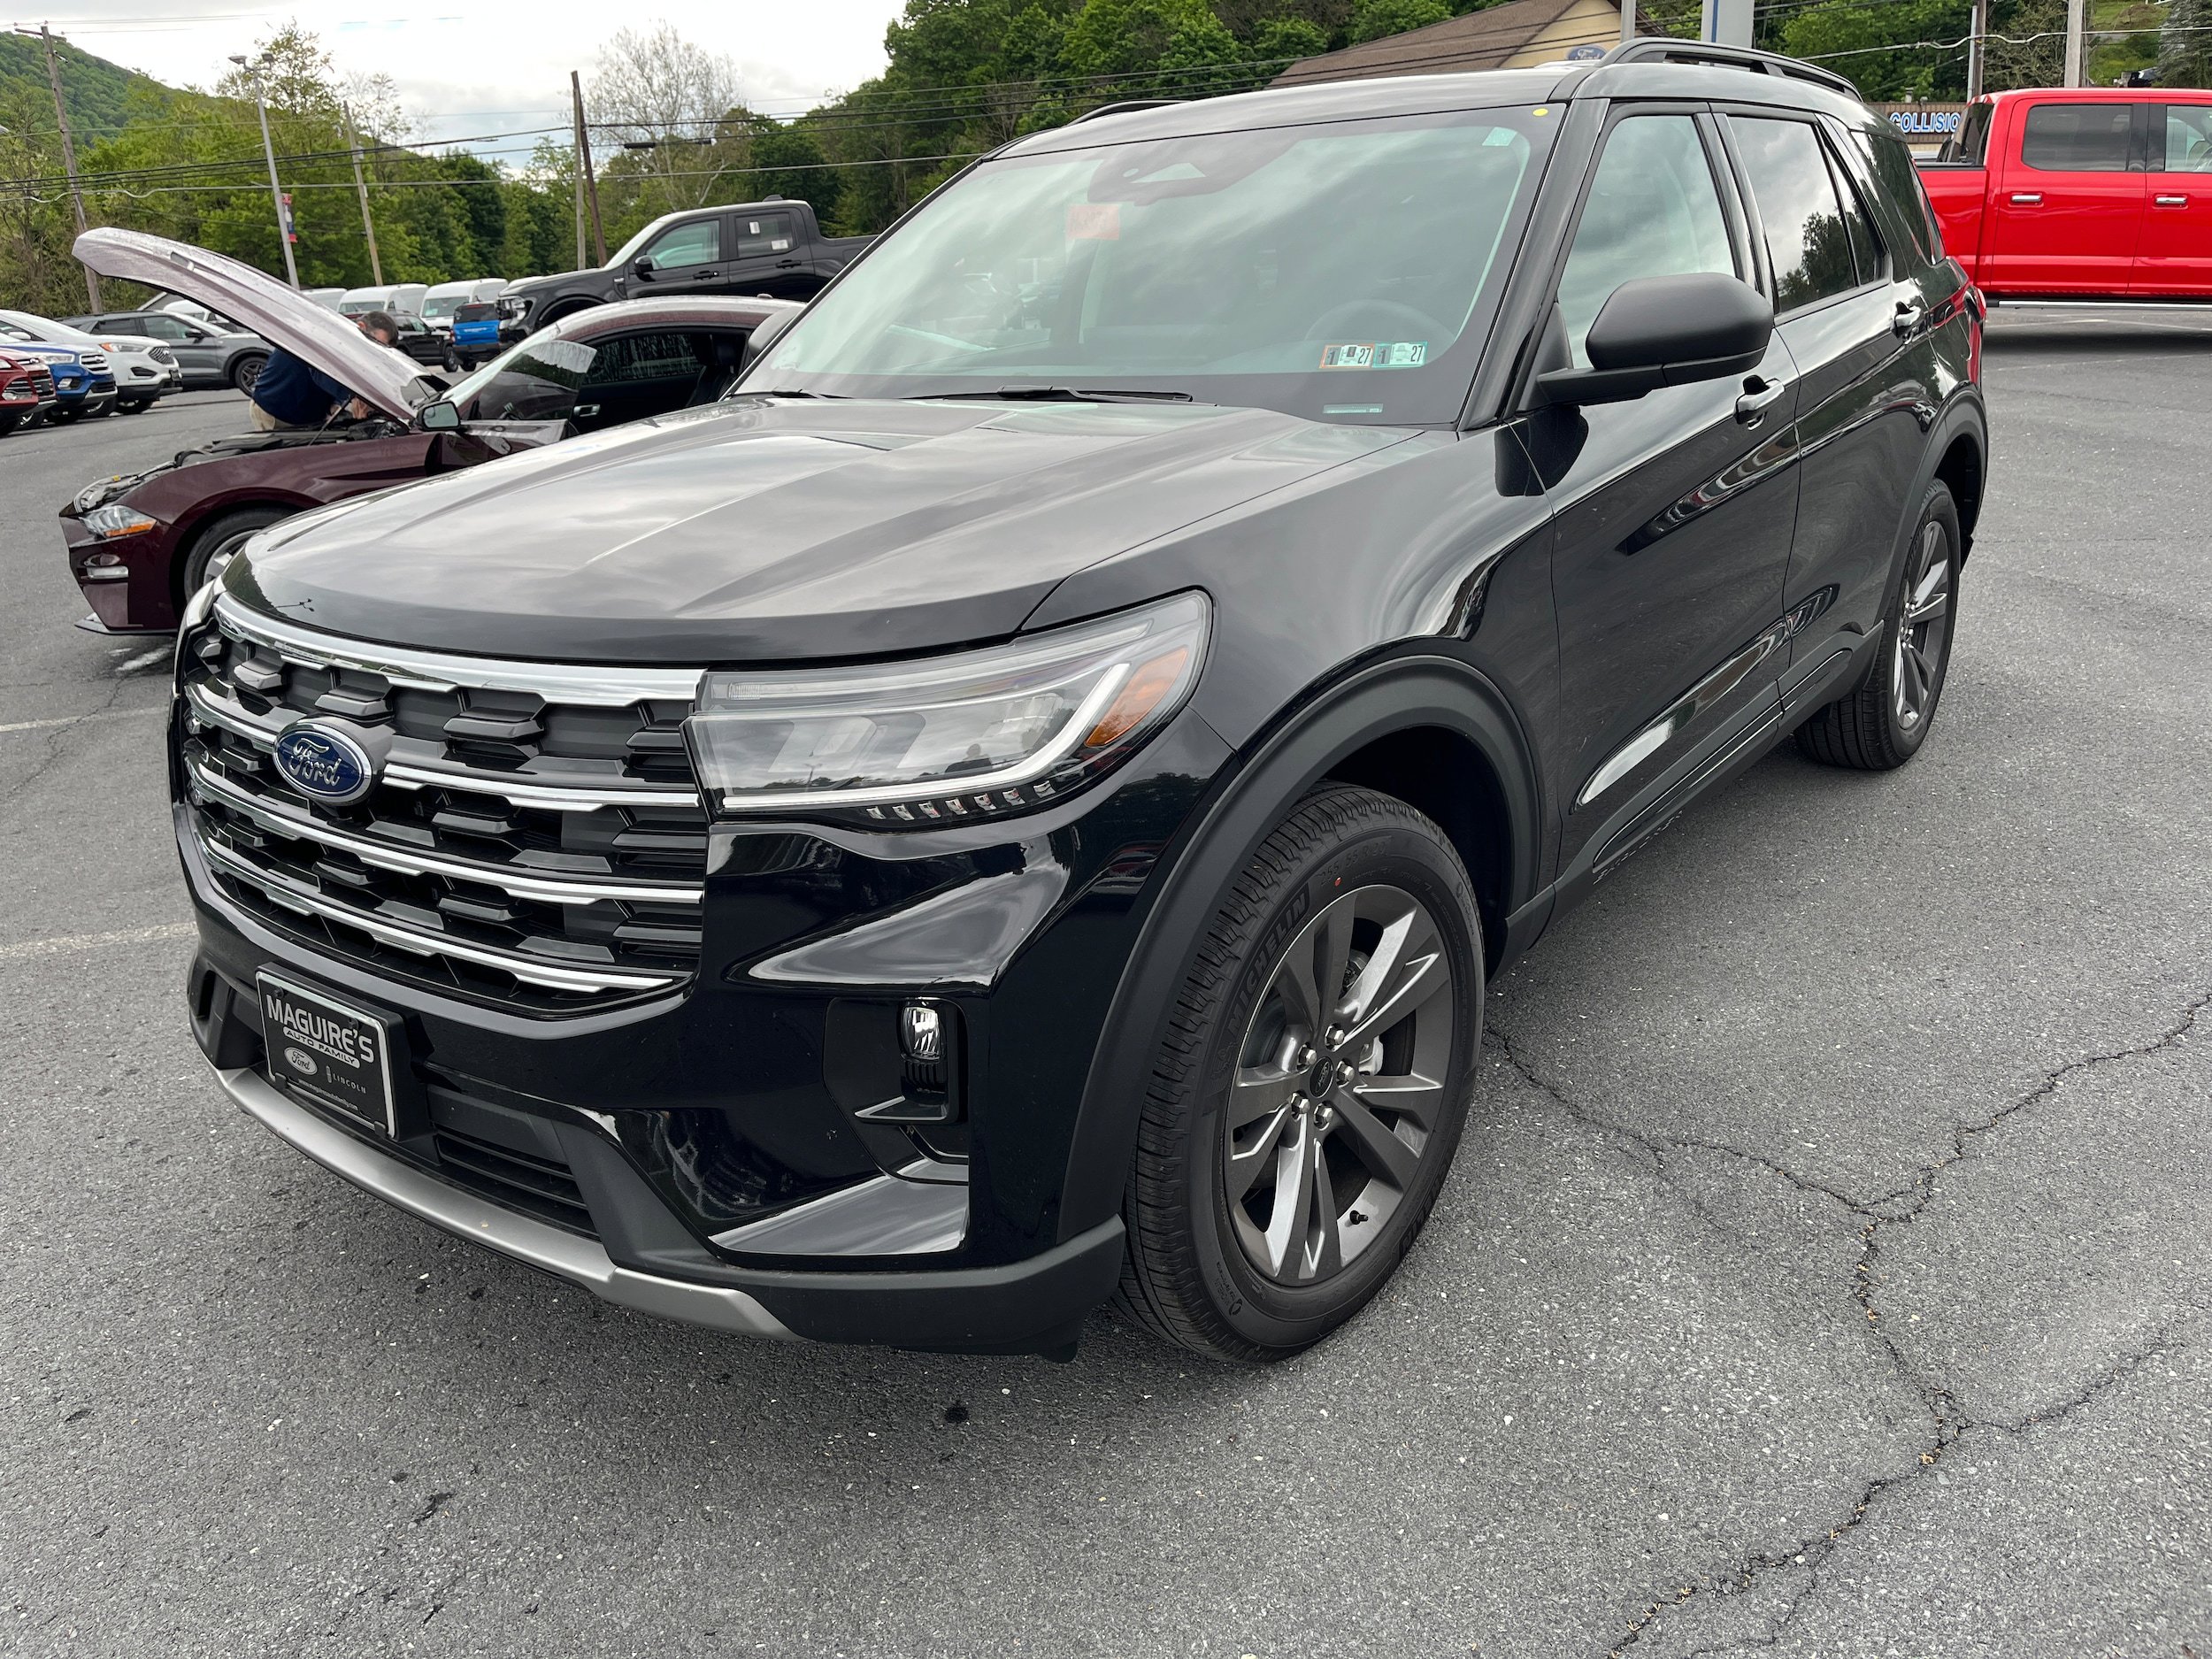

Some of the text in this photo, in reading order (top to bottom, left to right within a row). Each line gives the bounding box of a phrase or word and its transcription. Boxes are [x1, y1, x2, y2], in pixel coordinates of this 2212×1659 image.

[1357, 347, 1371, 365] 27
[1409, 344, 1424, 362] 27
[288, 737, 341, 787] Ford
[1226, 892, 1306, 1038] MICHELIN
[265, 994, 375, 1064] MAGUIRE'S
[286, 1029, 357, 1064] AUTO FAMILY
[290, 1050, 311, 1071] Ford
[333, 1072, 367, 1094] LINCOLN
